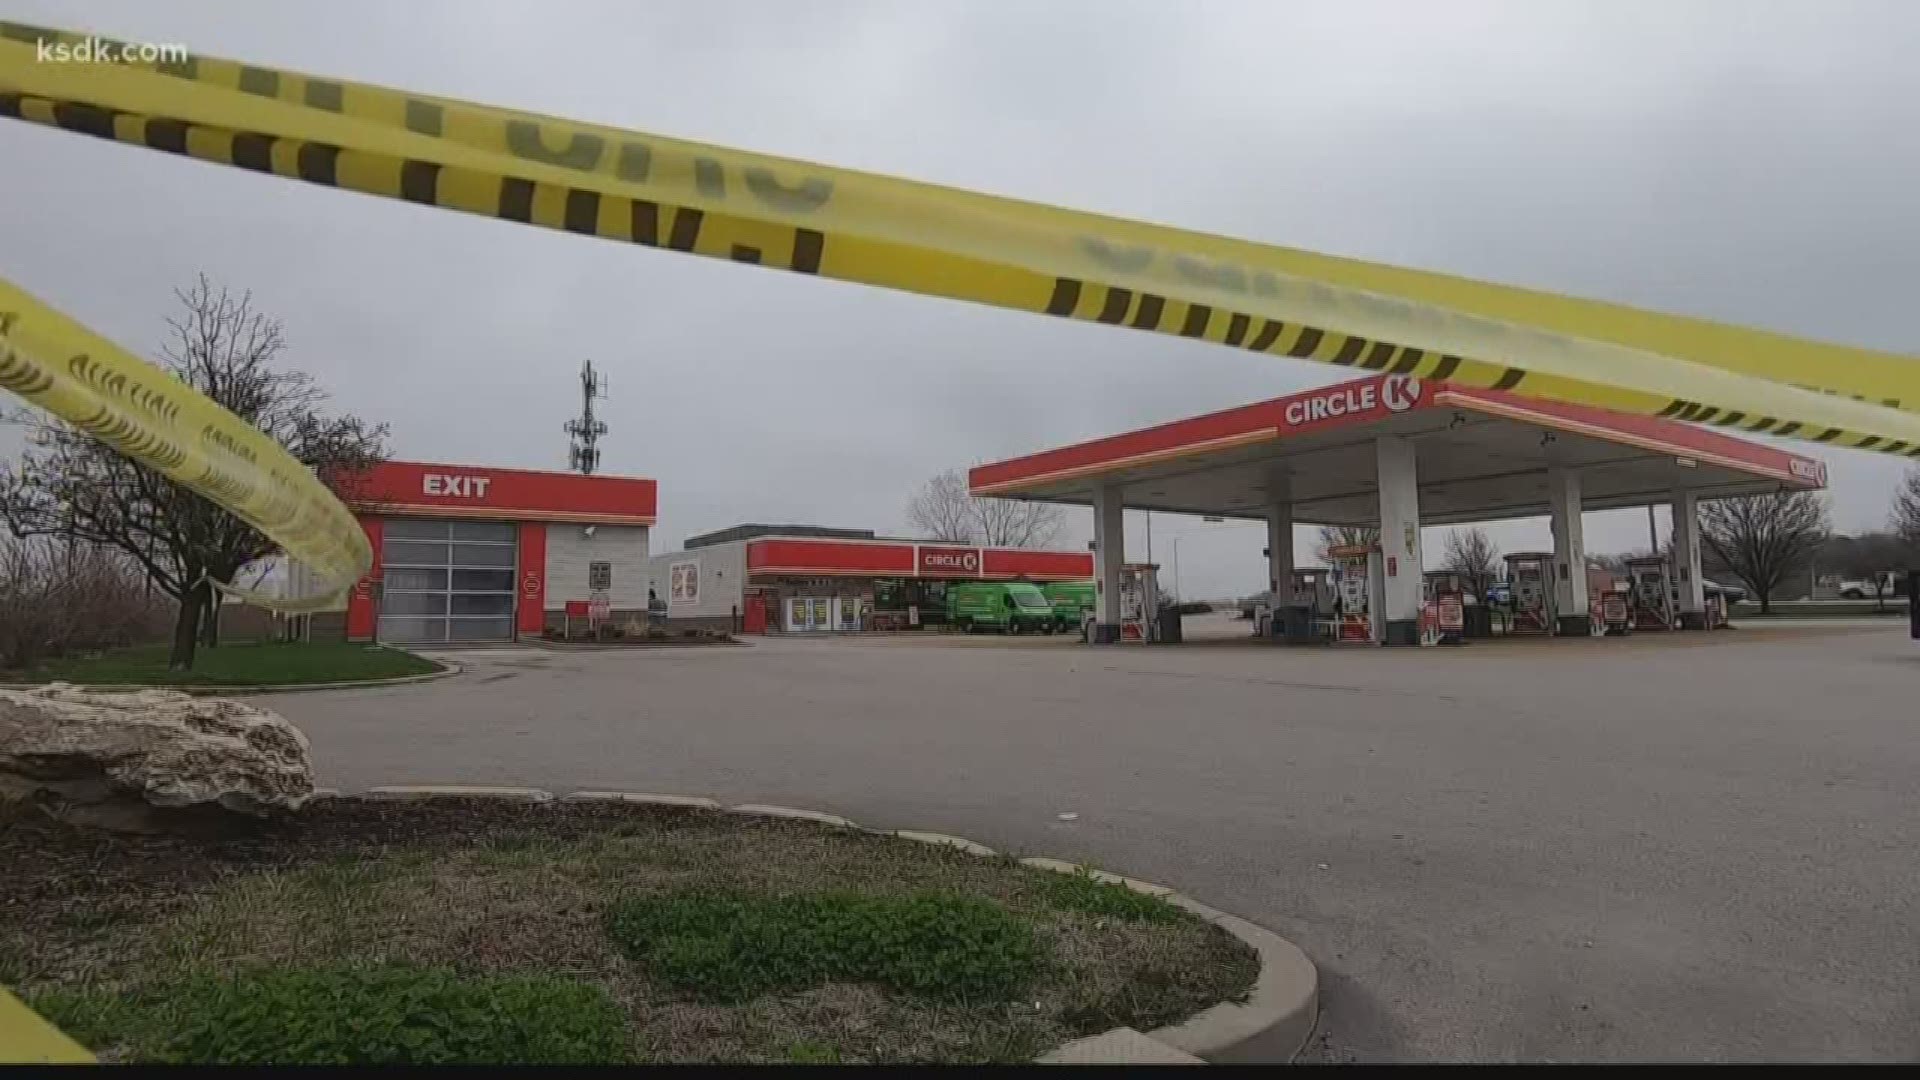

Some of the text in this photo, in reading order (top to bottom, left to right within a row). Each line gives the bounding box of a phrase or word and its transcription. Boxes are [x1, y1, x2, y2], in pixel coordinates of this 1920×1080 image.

[1285, 376, 1419, 425] CIRCLE K
[423, 473, 491, 497] EXIT
[925, 555, 962, 566] CIRCLE
